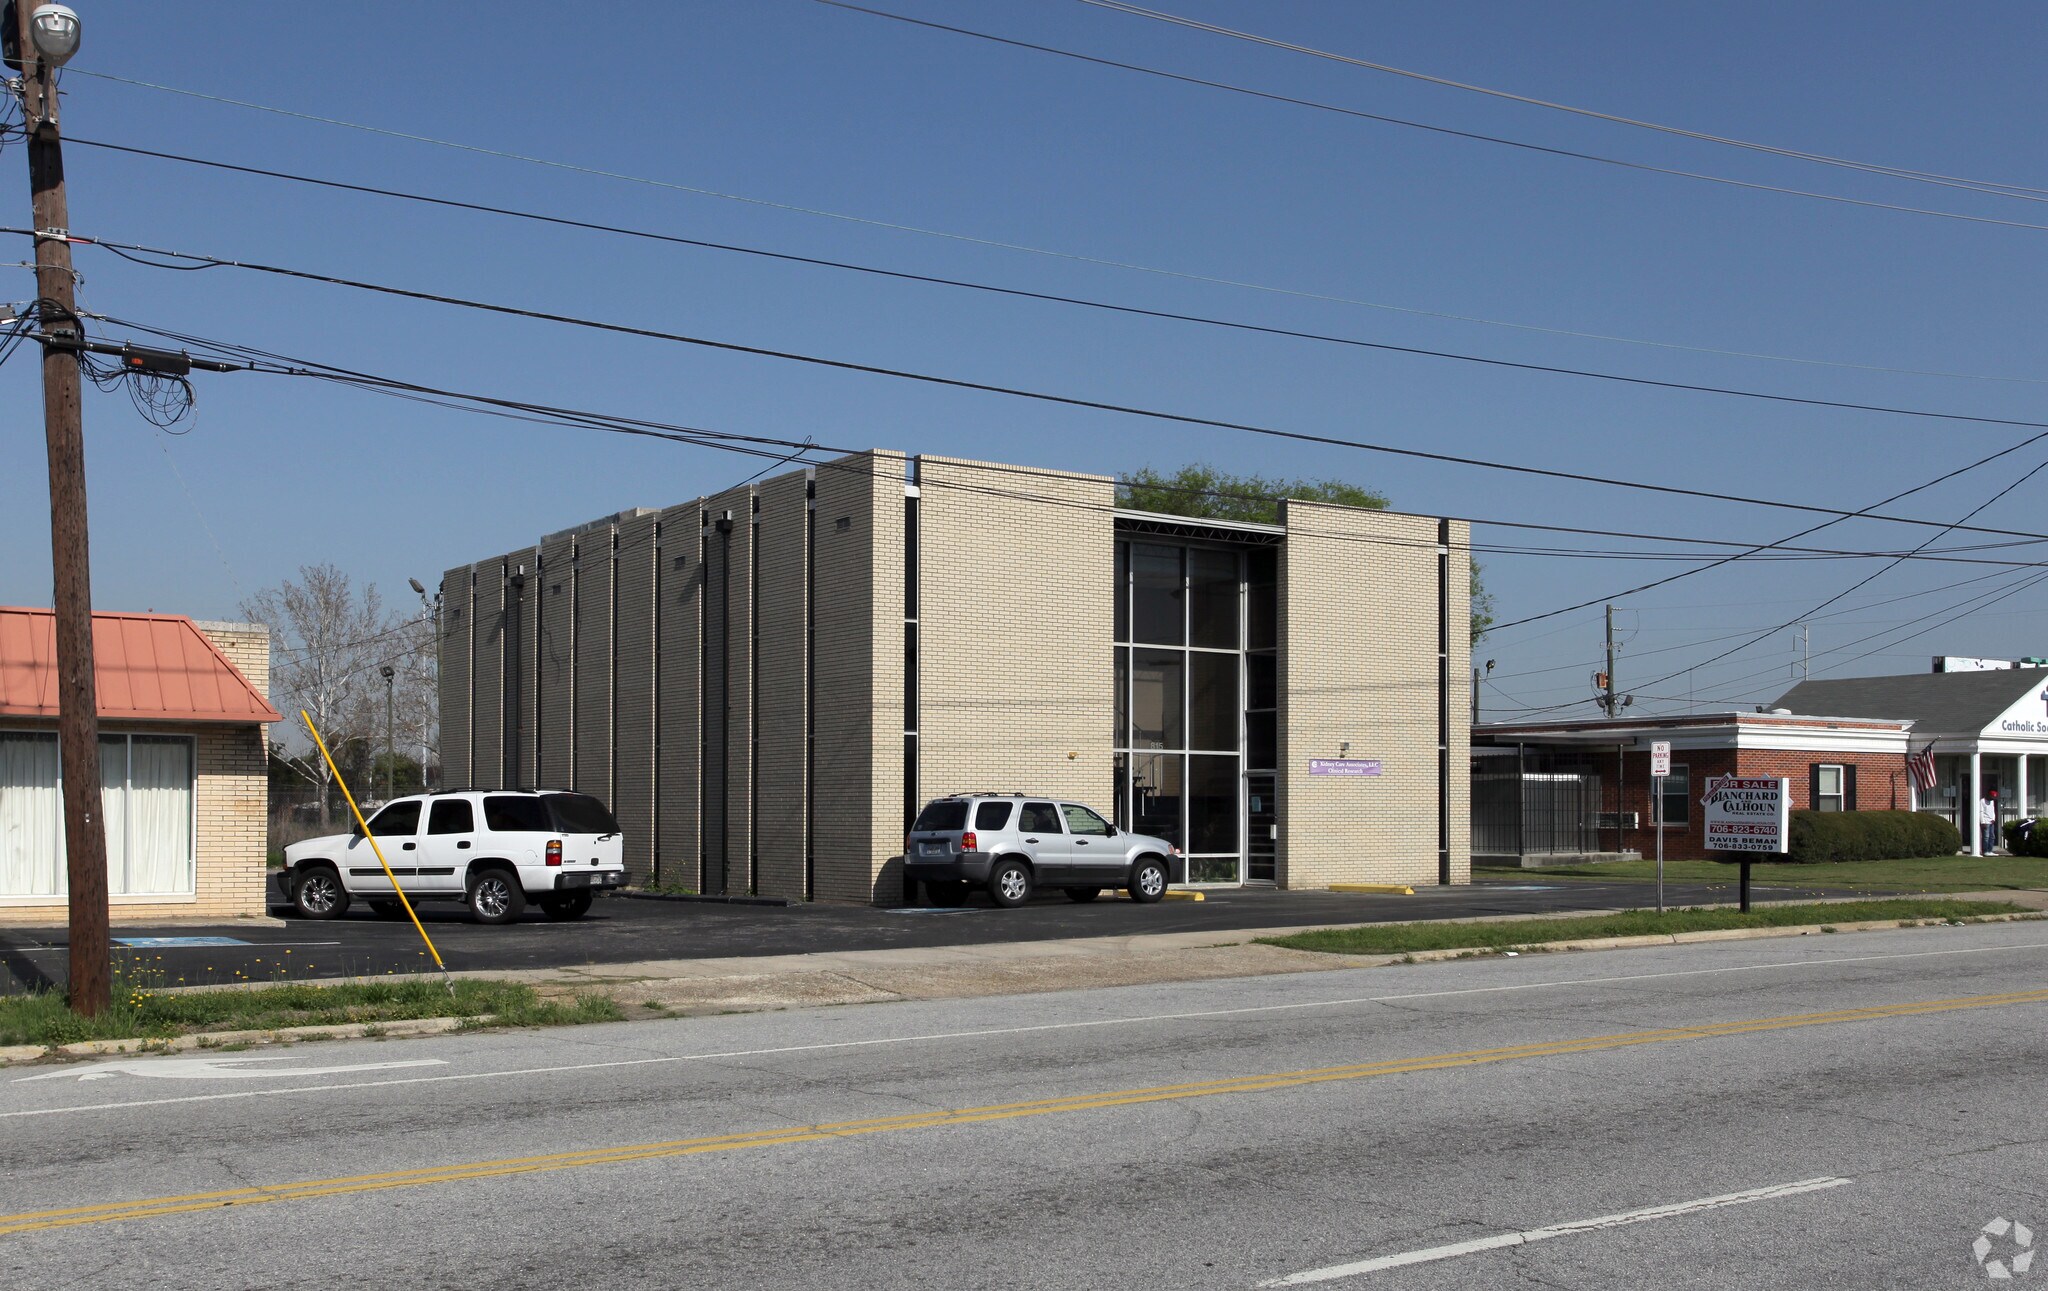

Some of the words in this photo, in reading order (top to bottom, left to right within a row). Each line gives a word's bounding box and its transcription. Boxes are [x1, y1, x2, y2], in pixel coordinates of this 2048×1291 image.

[2002, 719, 2034, 732] Catholic
[1710, 791, 1778, 806] BLANCHARD
[1723, 800, 1775, 813] CALHOUN
[1711, 825, 1776, 834] 706-823-6740
[1713, 843, 1773, 851] 706-833-0759
